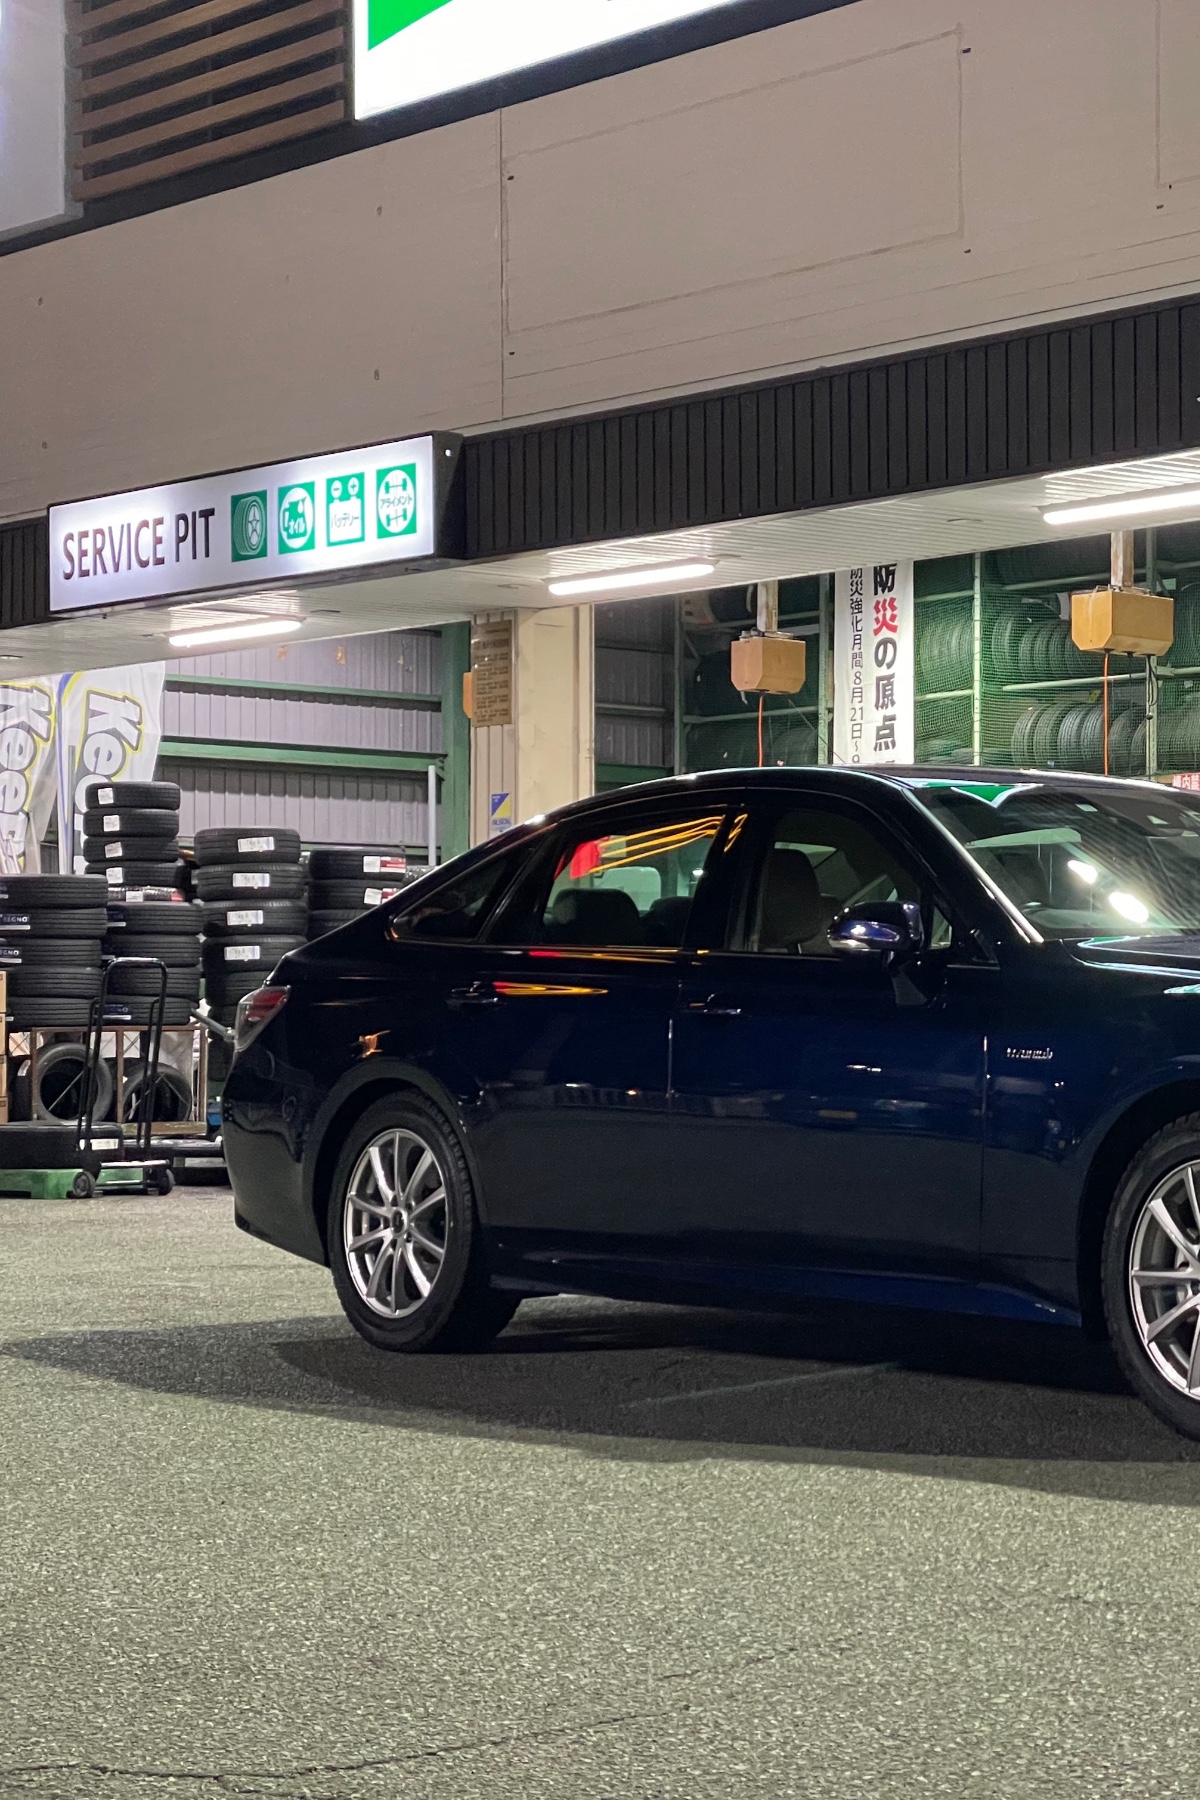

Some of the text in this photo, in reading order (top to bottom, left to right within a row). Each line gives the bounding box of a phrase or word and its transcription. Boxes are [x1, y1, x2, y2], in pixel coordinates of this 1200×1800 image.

[62, 508, 216, 581] SERVICE PIT
[873, 563, 898, 763] 防災の原点
